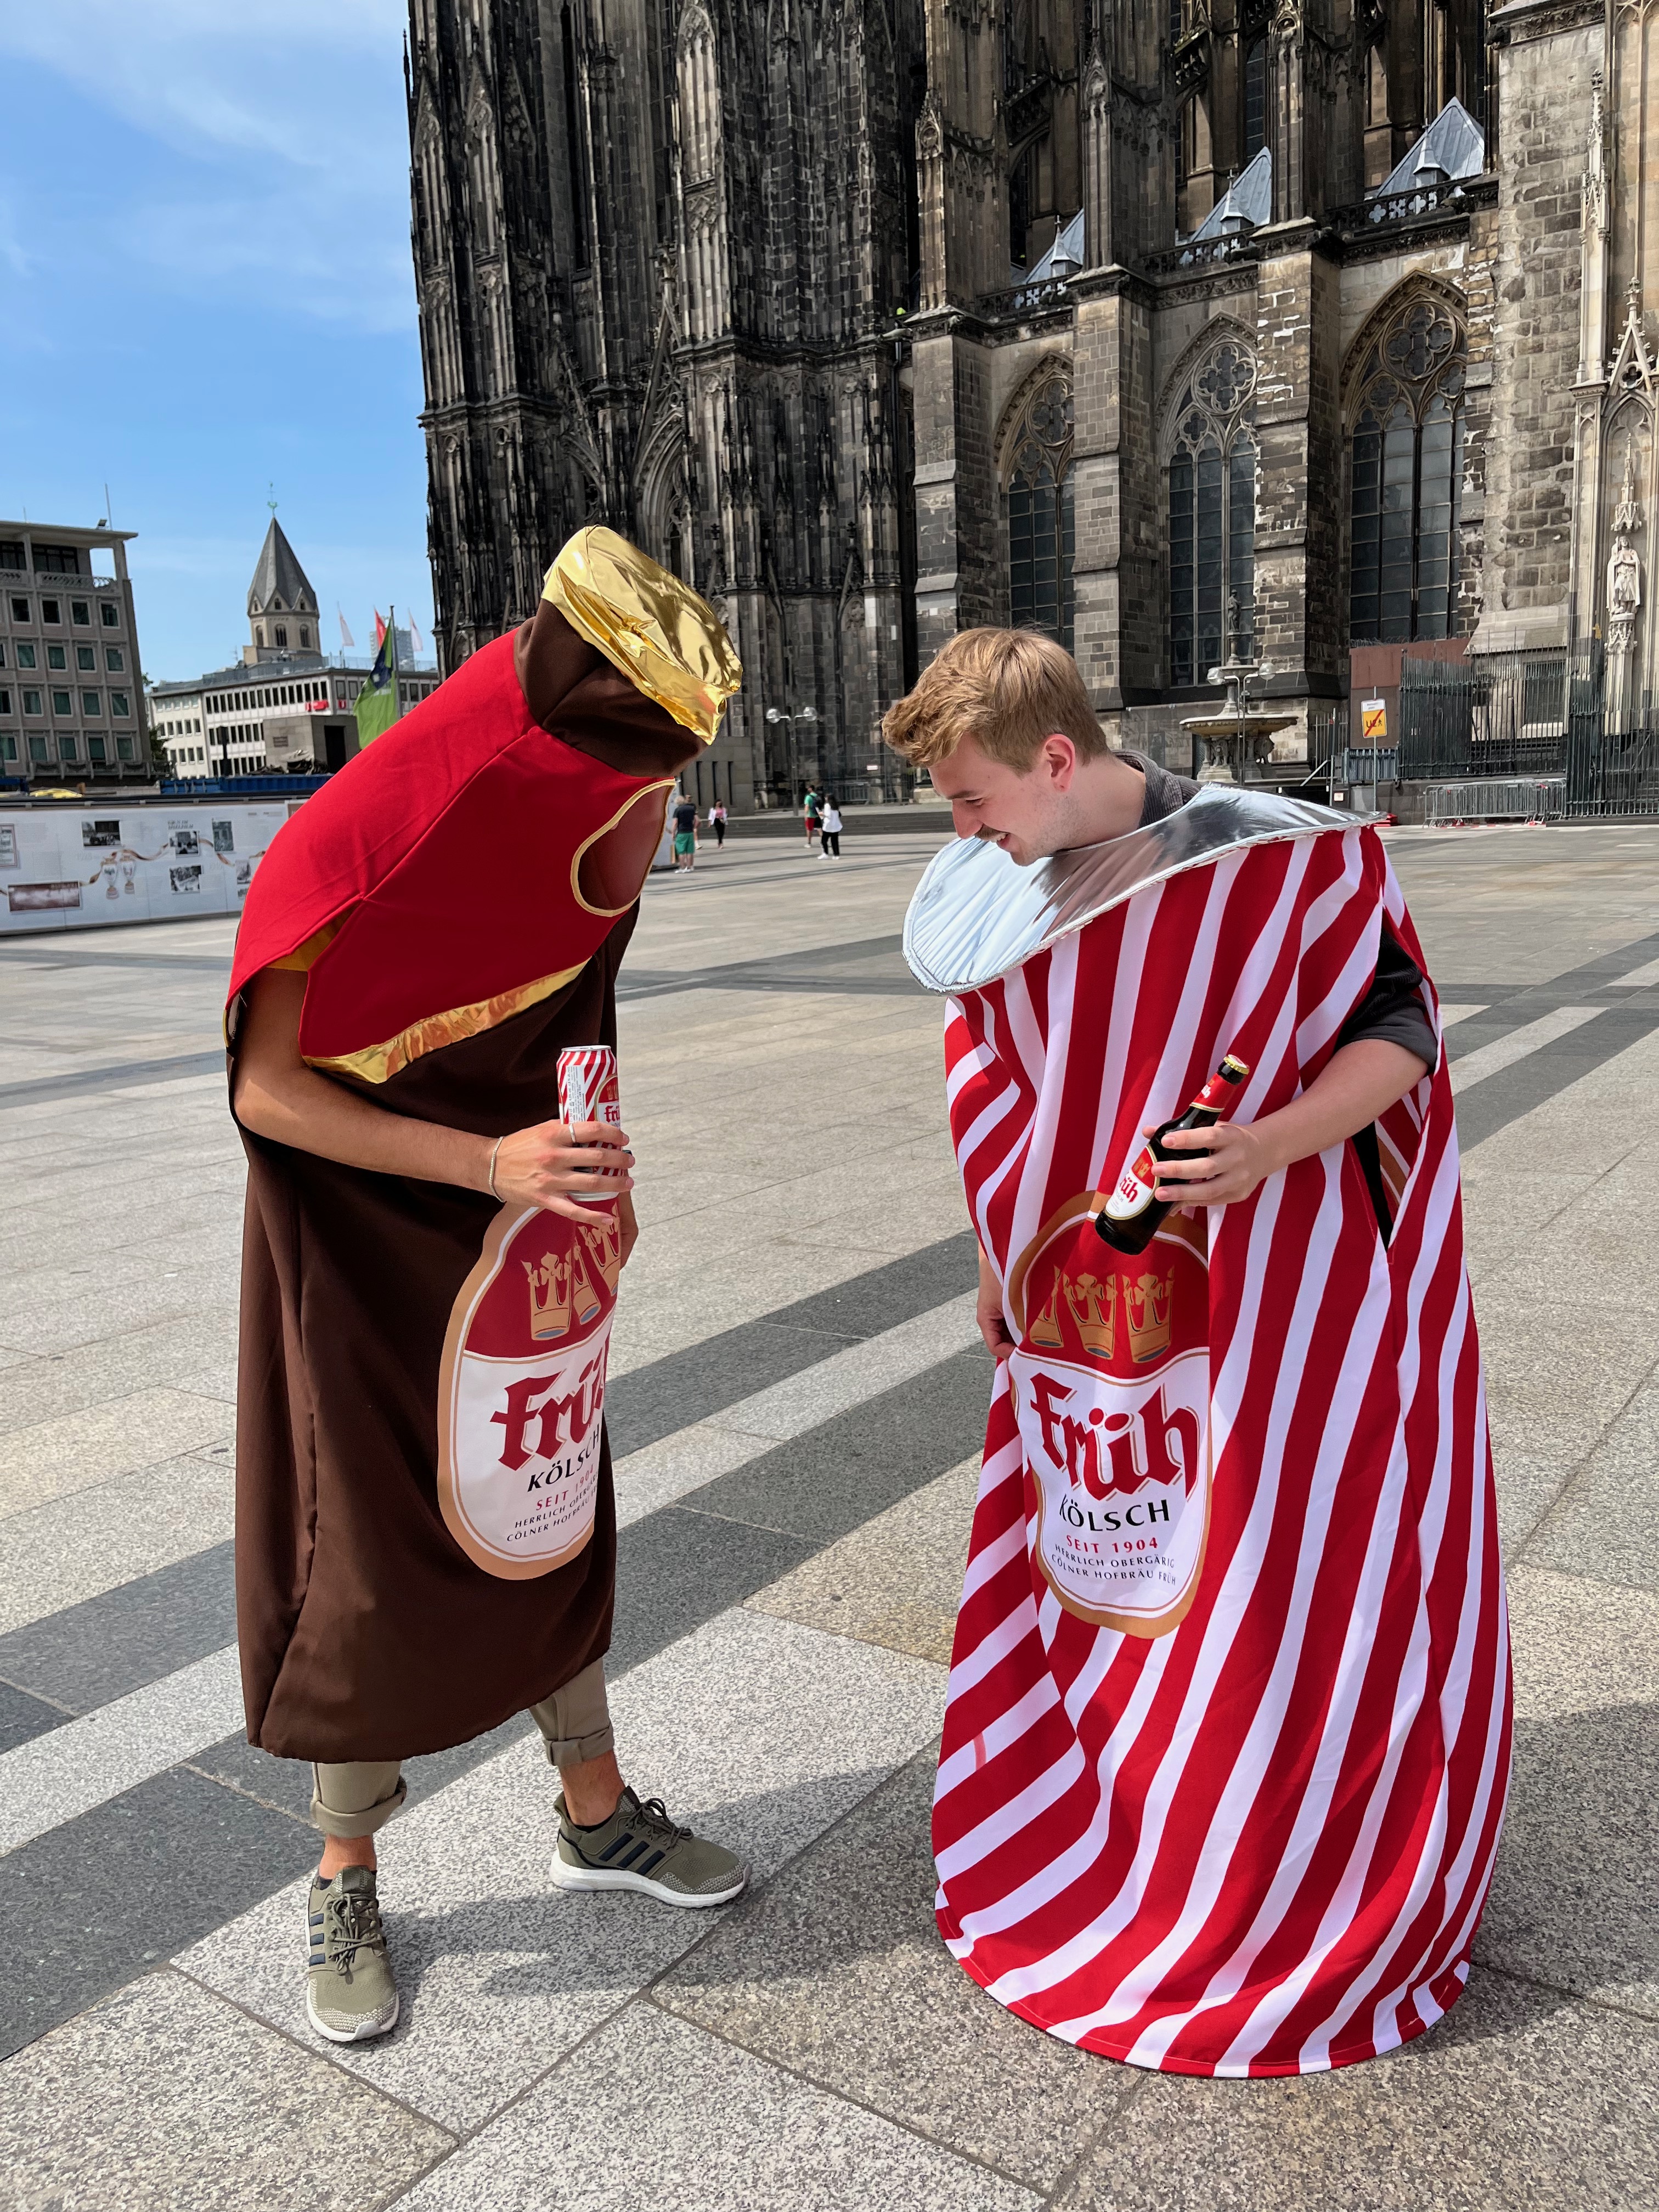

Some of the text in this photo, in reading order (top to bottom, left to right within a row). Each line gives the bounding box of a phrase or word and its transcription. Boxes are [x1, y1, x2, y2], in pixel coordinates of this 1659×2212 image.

[604, 1105, 620, 1122] Frü
[1030, 1372, 1200, 1502] Früh
[527, 1423, 600, 1492] KÖLSCH
[536, 1490, 569, 1510] SEIT
[1059, 1494, 1170, 1531] KÖLSCH
[507, 1496, 589, 1542] CÖLNER HOFBRÄU
[515, 1505, 566, 1528] HERRLICH
[1055, 1544, 1175, 1568] HERRLICH OBERGÄRIG
[1066, 1535, 1158, 1553] SEIT 1904
[1052, 1554, 1176, 1585] CÖLNER HOFBRÄU FRÜH
